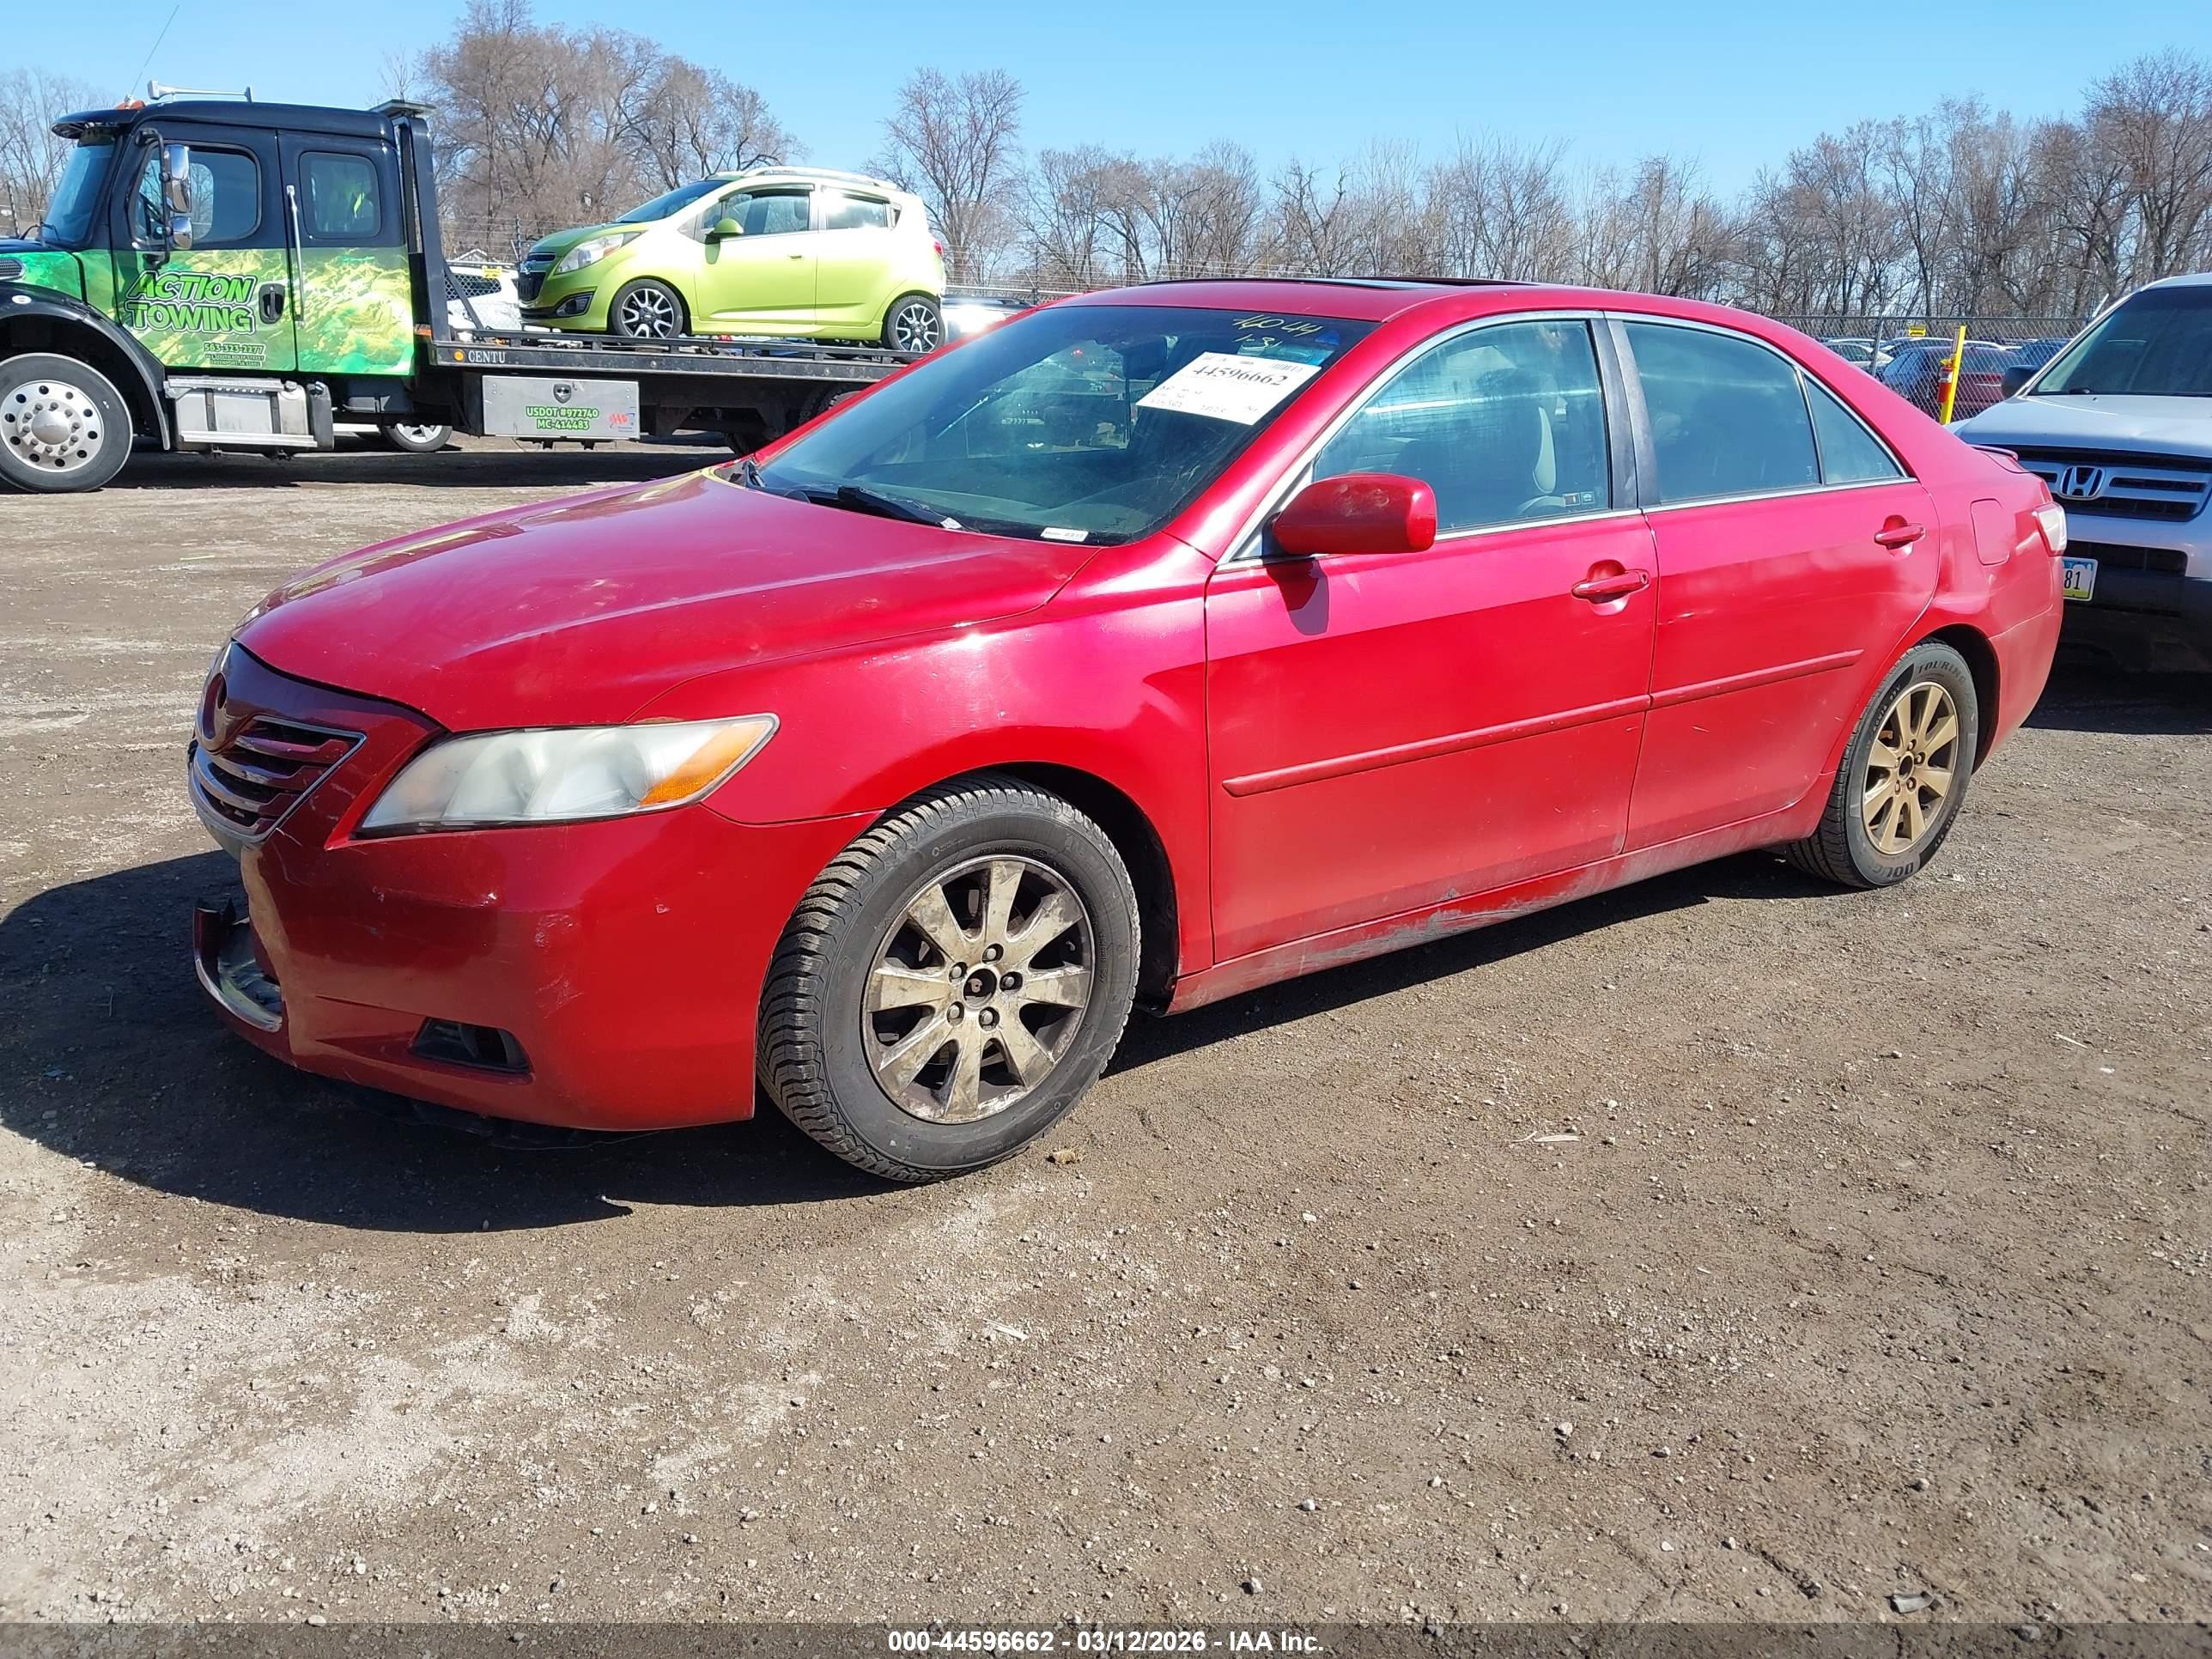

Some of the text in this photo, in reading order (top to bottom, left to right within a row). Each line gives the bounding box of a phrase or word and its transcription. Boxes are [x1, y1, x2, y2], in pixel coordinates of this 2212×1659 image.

[127, 272, 256, 303] ACTION
[126, 302, 254, 333] TOWING
[204, 343, 264, 355] 563-323-2277
[468, 350, 506, 363] CENTU
[1193, 364, 1288, 386] 44596662
[526, 407, 599, 419] USDOT #972740
[537, 418, 590, 430] MC-414483
[2064, 570, 2081, 591] 81
[1917, 659, 1966, 685] TOURING
